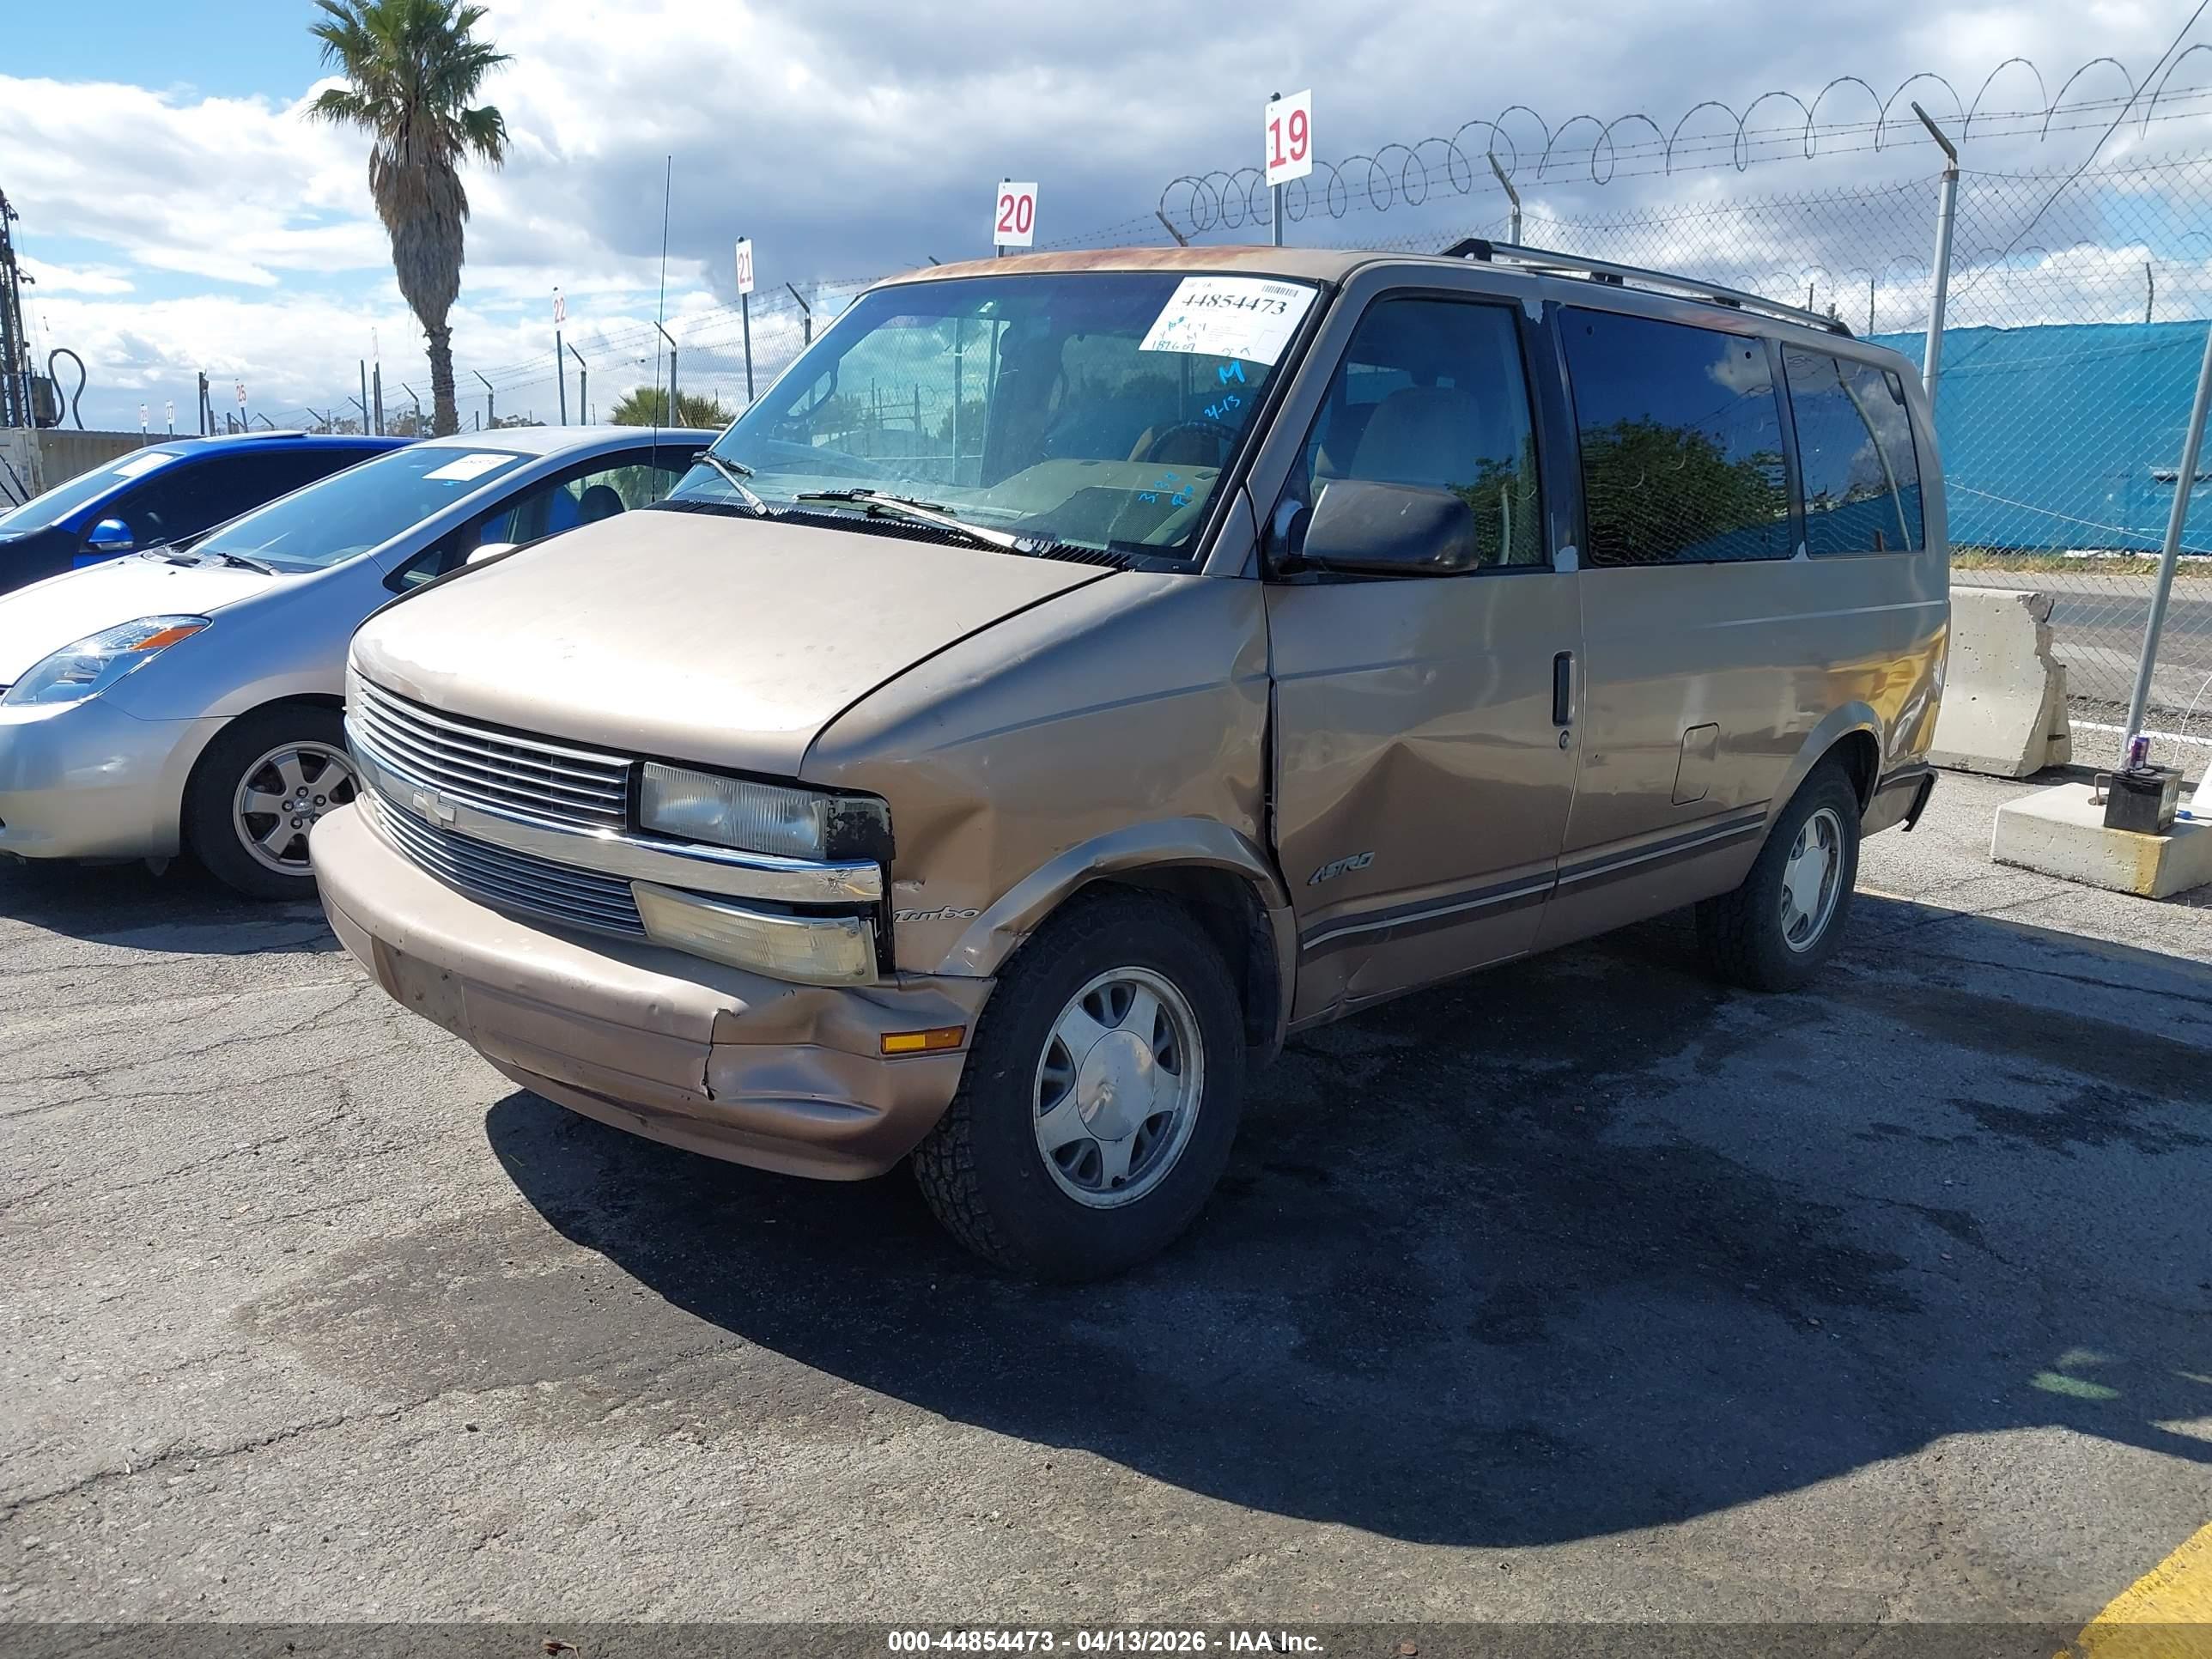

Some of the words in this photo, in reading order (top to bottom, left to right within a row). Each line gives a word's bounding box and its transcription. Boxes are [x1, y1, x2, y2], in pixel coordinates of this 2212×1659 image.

[1269, 109, 1308, 169] 19
[998, 194, 1032, 234] 20
[738, 251, 751, 284] 21
[554, 297, 565, 324] 22
[1182, 294, 1288, 315] 44854473
[1218, 360, 1245, 386] M
[893, 905, 979, 923] Turbo
